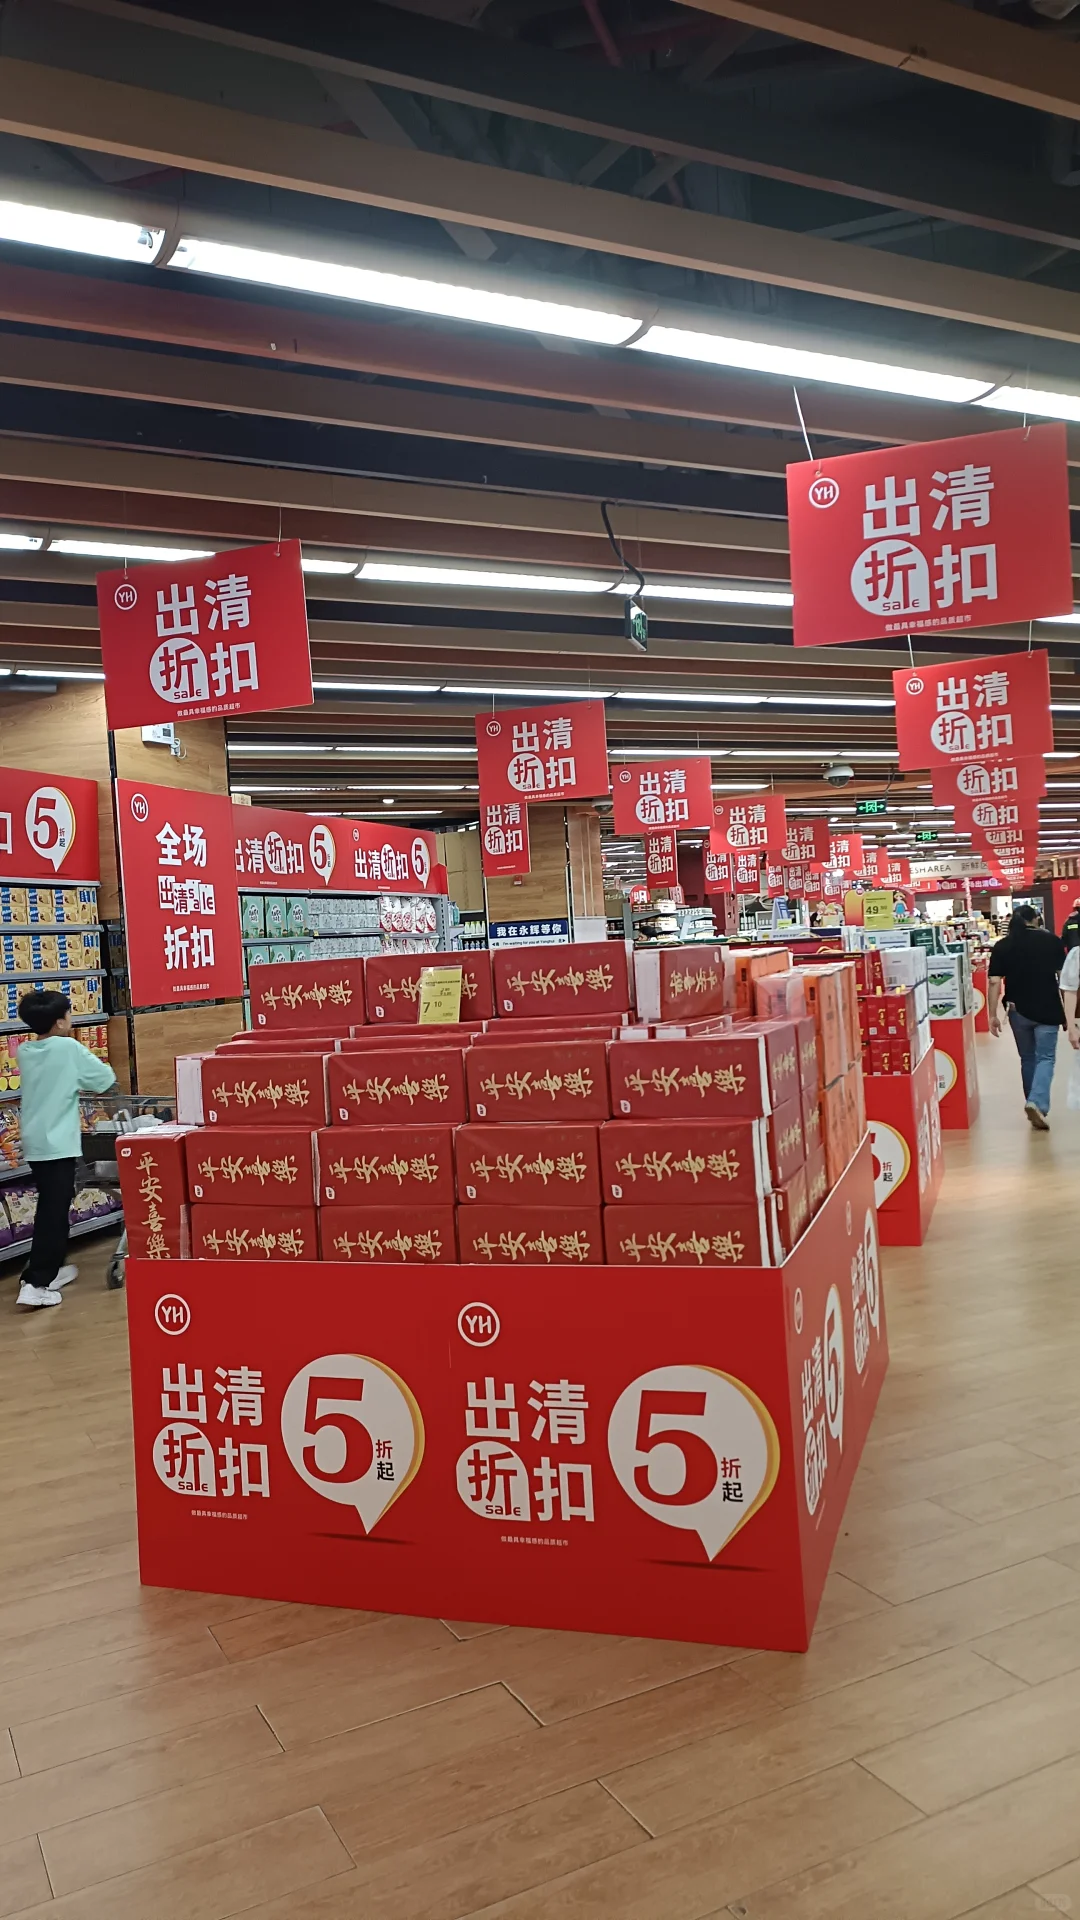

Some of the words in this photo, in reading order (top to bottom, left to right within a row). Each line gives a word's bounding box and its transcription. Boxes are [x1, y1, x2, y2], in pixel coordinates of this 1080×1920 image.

[814, 485, 834, 500] YH
[863, 464, 995, 540] 出清
[864, 543, 998, 610] 折扣
[118, 590, 133, 603] YH
[155, 574, 251, 638] 出清
[882, 598, 920, 612] sale
[158, 642, 259, 698] 折扣
[174, 688, 202, 700] sale
[936, 671, 1010, 712] 出清
[511, 717, 574, 753] 出清
[938, 713, 1014, 750] 折扣
[513, 756, 577, 789] 折扣
[639, 769, 687, 796] 出清
[962, 766, 1018, 794] 折扣
[134, 800, 146, 815] YH
[486, 803, 521, 827] 出清
[641, 797, 689, 823] 折扣
[729, 804, 767, 825] 出清
[977, 805, 1019, 825] 折扣
[33, 796, 59, 850] 5
[155, 822, 207, 868] 全场
[488, 829, 524, 854] 折扣
[648, 835, 672, 855] 出清
[730, 826, 768, 845] 折扣
[313, 832, 327, 869] 5
[738, 854, 757, 868] 出清
[786, 844, 816, 861] 折扣
[354, 848, 409, 881] 出清折扣
[414, 844, 425, 875] 5
[649, 855, 674, 873] 折扣
[707, 865, 729, 881] 折扣
[927, 864, 952, 873] AREA
[738, 868, 758, 883] 折扣
[866, 905, 879, 915] 49
[163, 925, 215, 970] 折扣
[422, 1001, 431, 1014] 7
[882, 1160, 894, 1183] 折起
[161, 1305, 185, 1324] YH
[465, 1314, 493, 1334] YH
[160, 1363, 266, 1427] 出清
[302, 1375, 374, 1484] 5
[465, 1376, 589, 1446] 出清
[633, 1389, 718, 1506] 5
[162, 1429, 271, 1498] 折扣
[177, 1480, 209, 1492] sale
[467, 1448, 595, 1522] 折扣
[485, 1503, 521, 1517] sale
